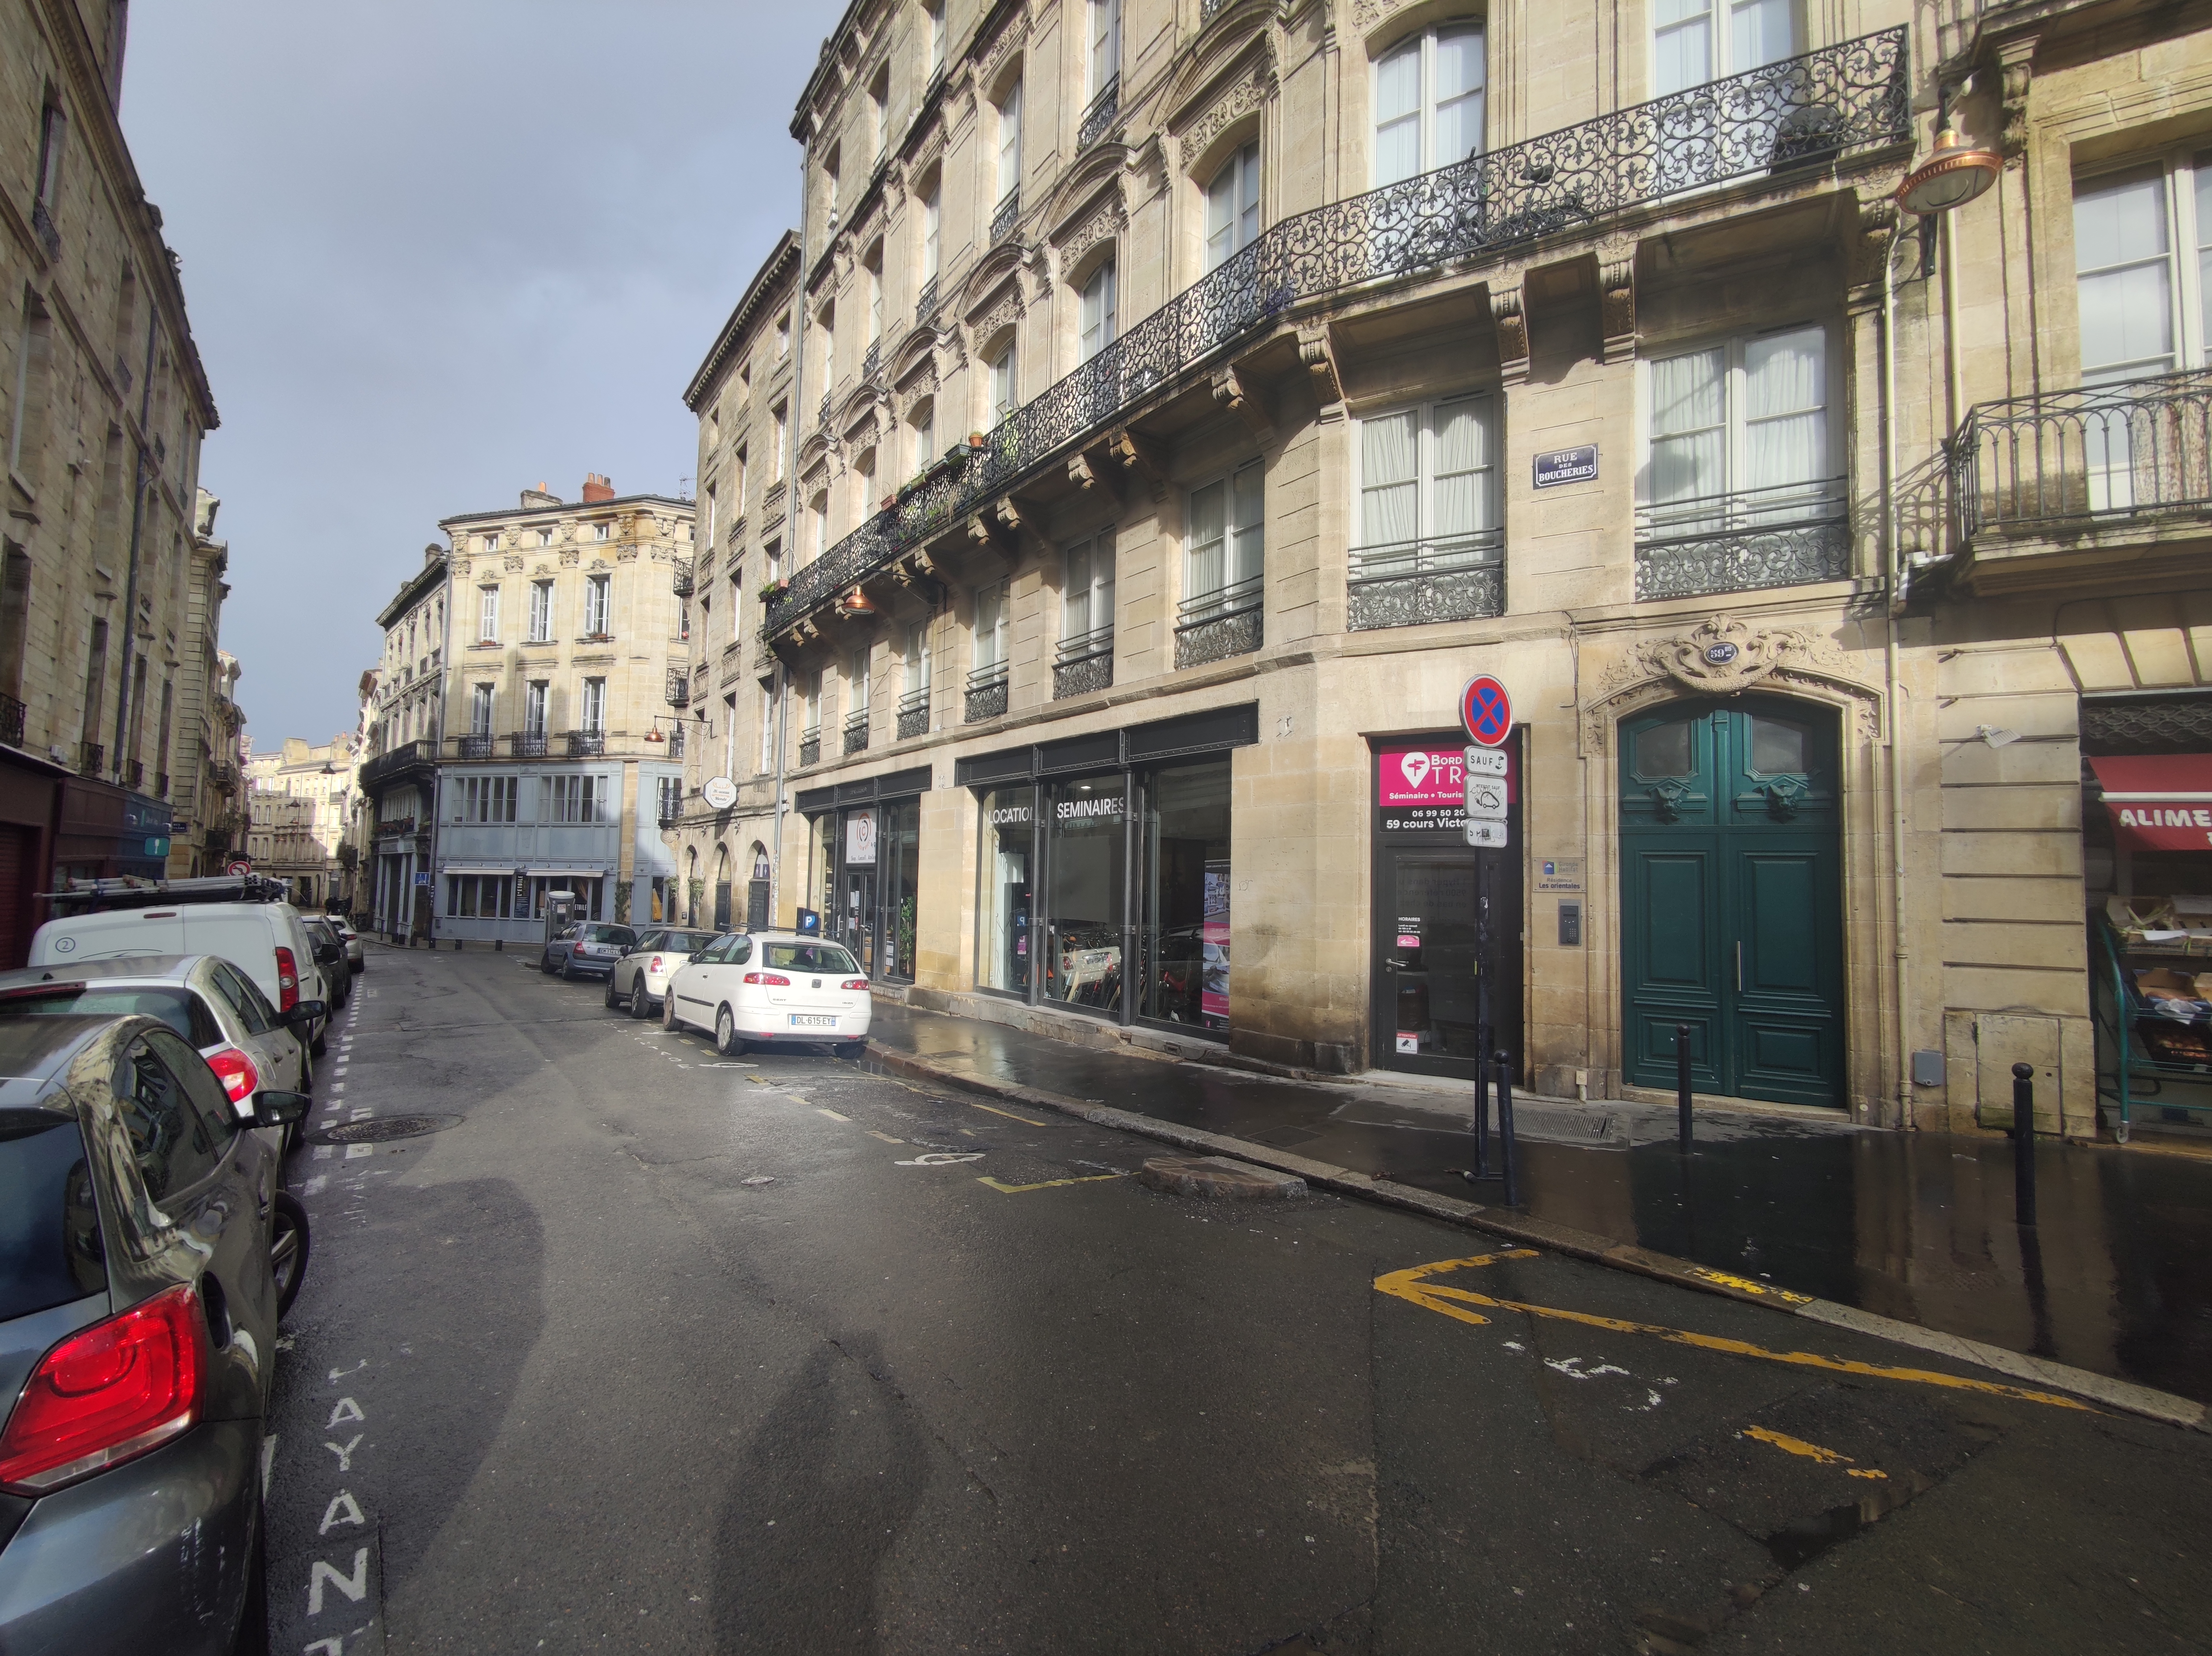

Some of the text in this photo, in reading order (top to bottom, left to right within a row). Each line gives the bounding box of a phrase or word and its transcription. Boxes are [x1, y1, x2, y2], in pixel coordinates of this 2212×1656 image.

[1554, 452, 1578, 464] RUE
[1539, 464, 1593, 482] BOUCHERIES
[1710, 649, 1724, 658] 59
[1470, 755, 1493, 766] SAUF
[1057, 796, 1124, 819] SEMINAIRES
[2119, 809, 2212, 827] ALIME
[1386, 819, 1400, 829] 59
[1403, 820, 1434, 829] cours
[806, 916, 812, 926] P
[62, 941, 69, 950] 2
